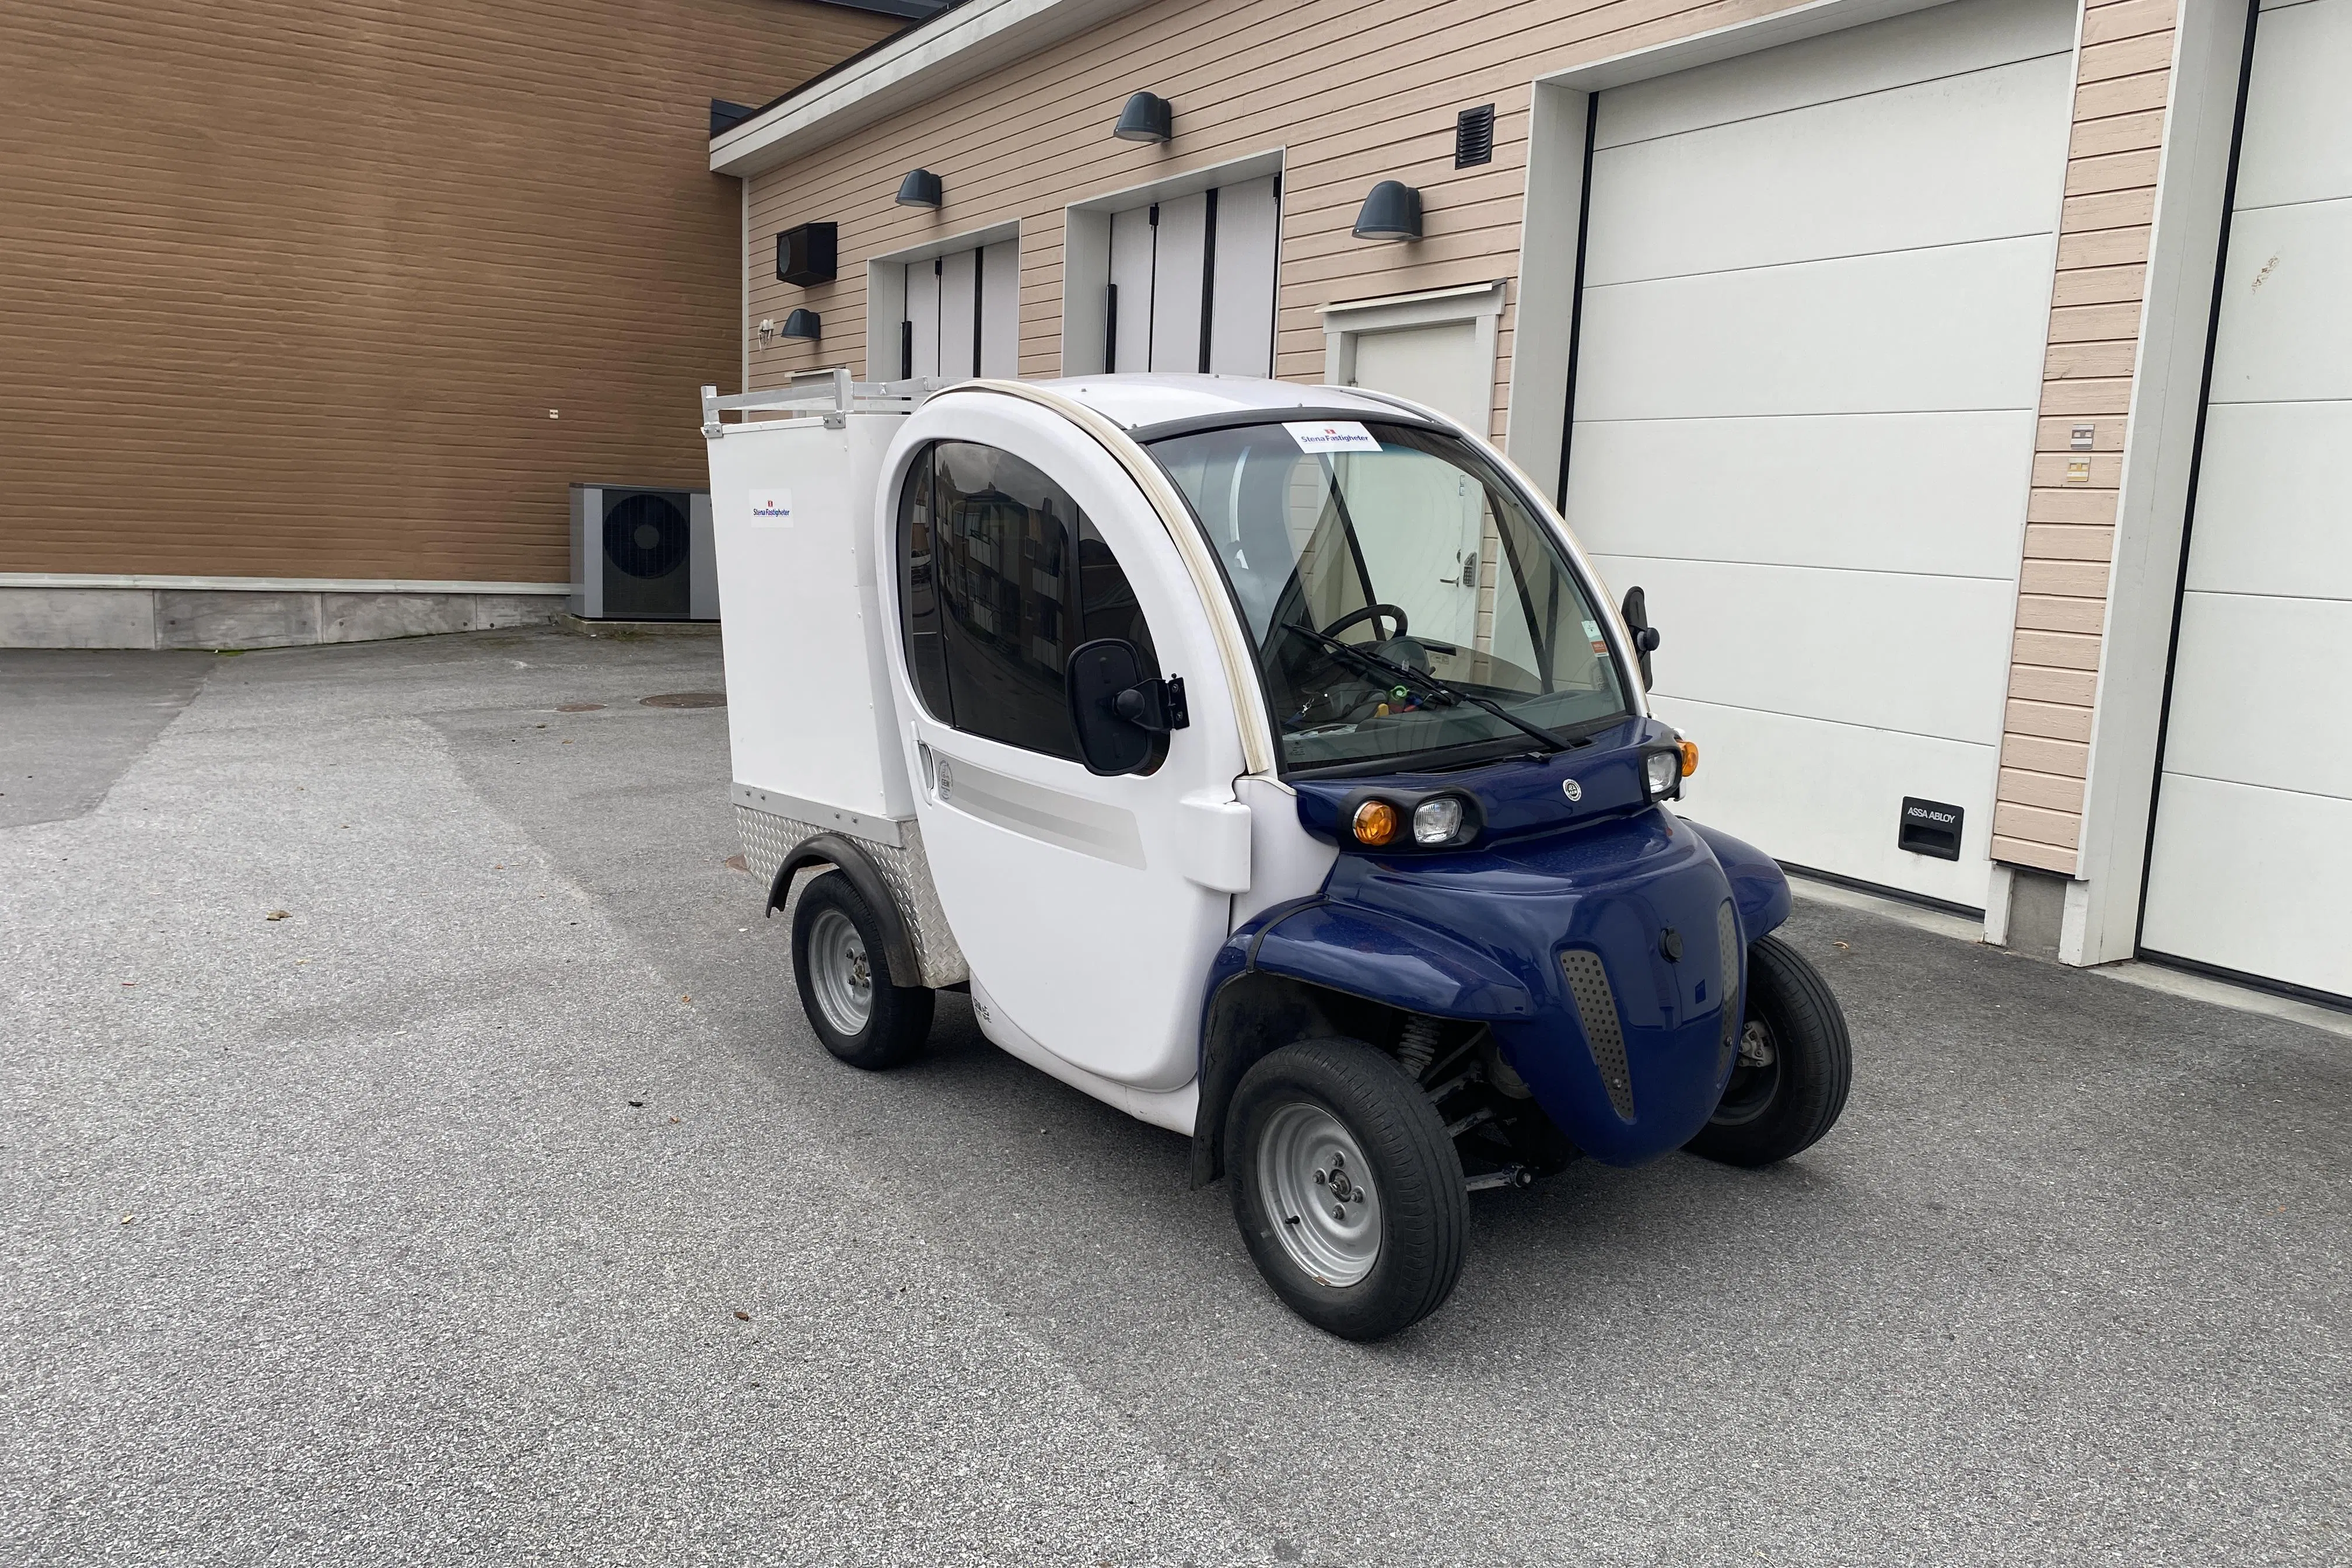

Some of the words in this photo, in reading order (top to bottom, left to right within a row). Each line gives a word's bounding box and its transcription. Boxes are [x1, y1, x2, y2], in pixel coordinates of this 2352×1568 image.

[765, 509, 789, 517] Fastigheter
[1908, 807, 1927, 818] ASSA
[1929, 811, 1955, 823] ABLOY
